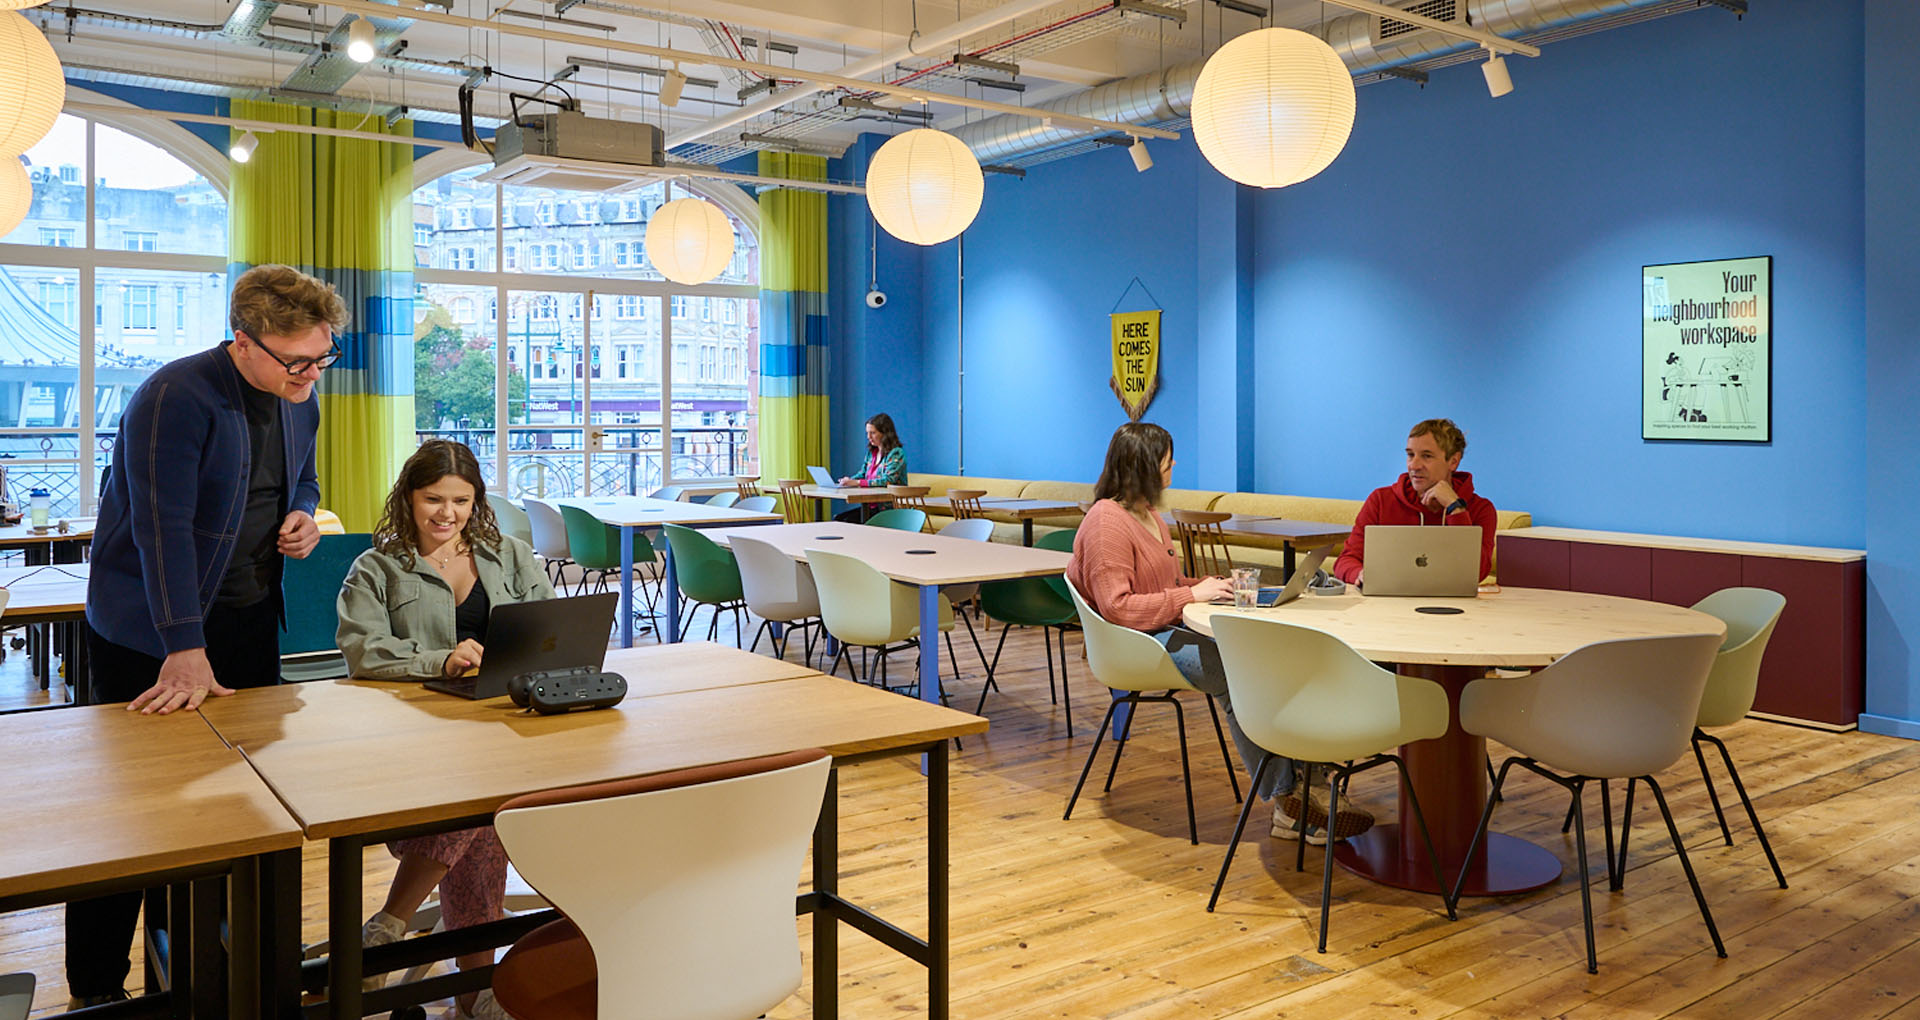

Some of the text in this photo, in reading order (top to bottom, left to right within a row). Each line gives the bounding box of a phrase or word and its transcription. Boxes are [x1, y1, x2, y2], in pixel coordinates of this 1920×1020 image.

[1722, 271, 1757, 293] Your
[1653, 296, 1757, 325] neighbourhood
[1122, 322, 1149, 337] HERE
[1681, 323, 1757, 348] workspace
[1119, 340, 1151, 356] COMES
[1126, 359, 1144, 374] THE
[1125, 377, 1145, 392] SUN
[529, 402, 558, 410] NatWest
[671, 402, 693, 410] atWest
